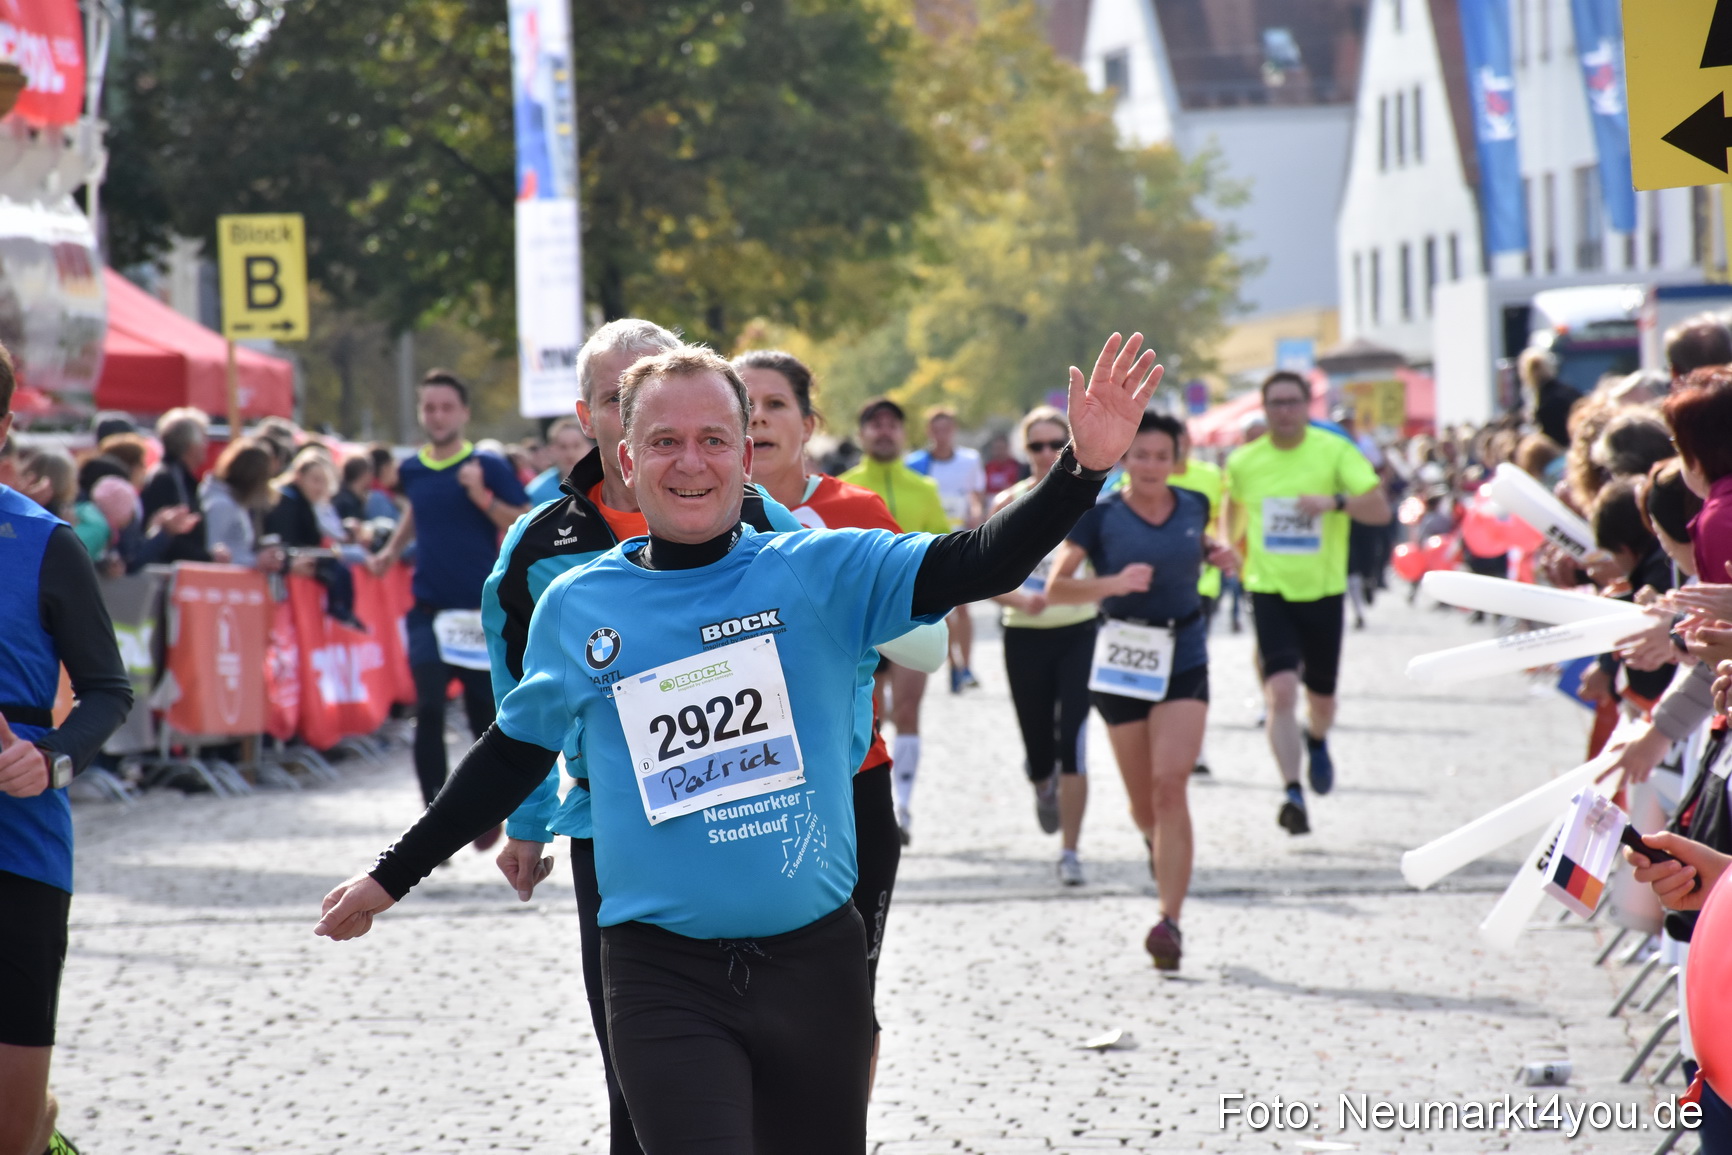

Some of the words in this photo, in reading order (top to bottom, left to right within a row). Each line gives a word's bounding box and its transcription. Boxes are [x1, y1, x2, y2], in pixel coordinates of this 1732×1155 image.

[231, 224, 293, 245] Block
[245, 255, 284, 311] B
[553, 536, 578, 547] erima
[588, 629, 618, 647] BMW
[700, 608, 784, 644] BOCK
[1107, 643, 1160, 671] 2325
[589, 669, 625, 685] ARTL
[675, 660, 732, 687] BOCK
[649, 688, 769, 762] 2922
[661, 743, 782, 801] Patrick
[703, 792, 801, 824] Neumarkter
[708, 813, 788, 844] Stadtlauf
[787, 868, 797, 879] 17.
[793, 831, 812, 869] September
[807, 813, 819, 832] 2017
